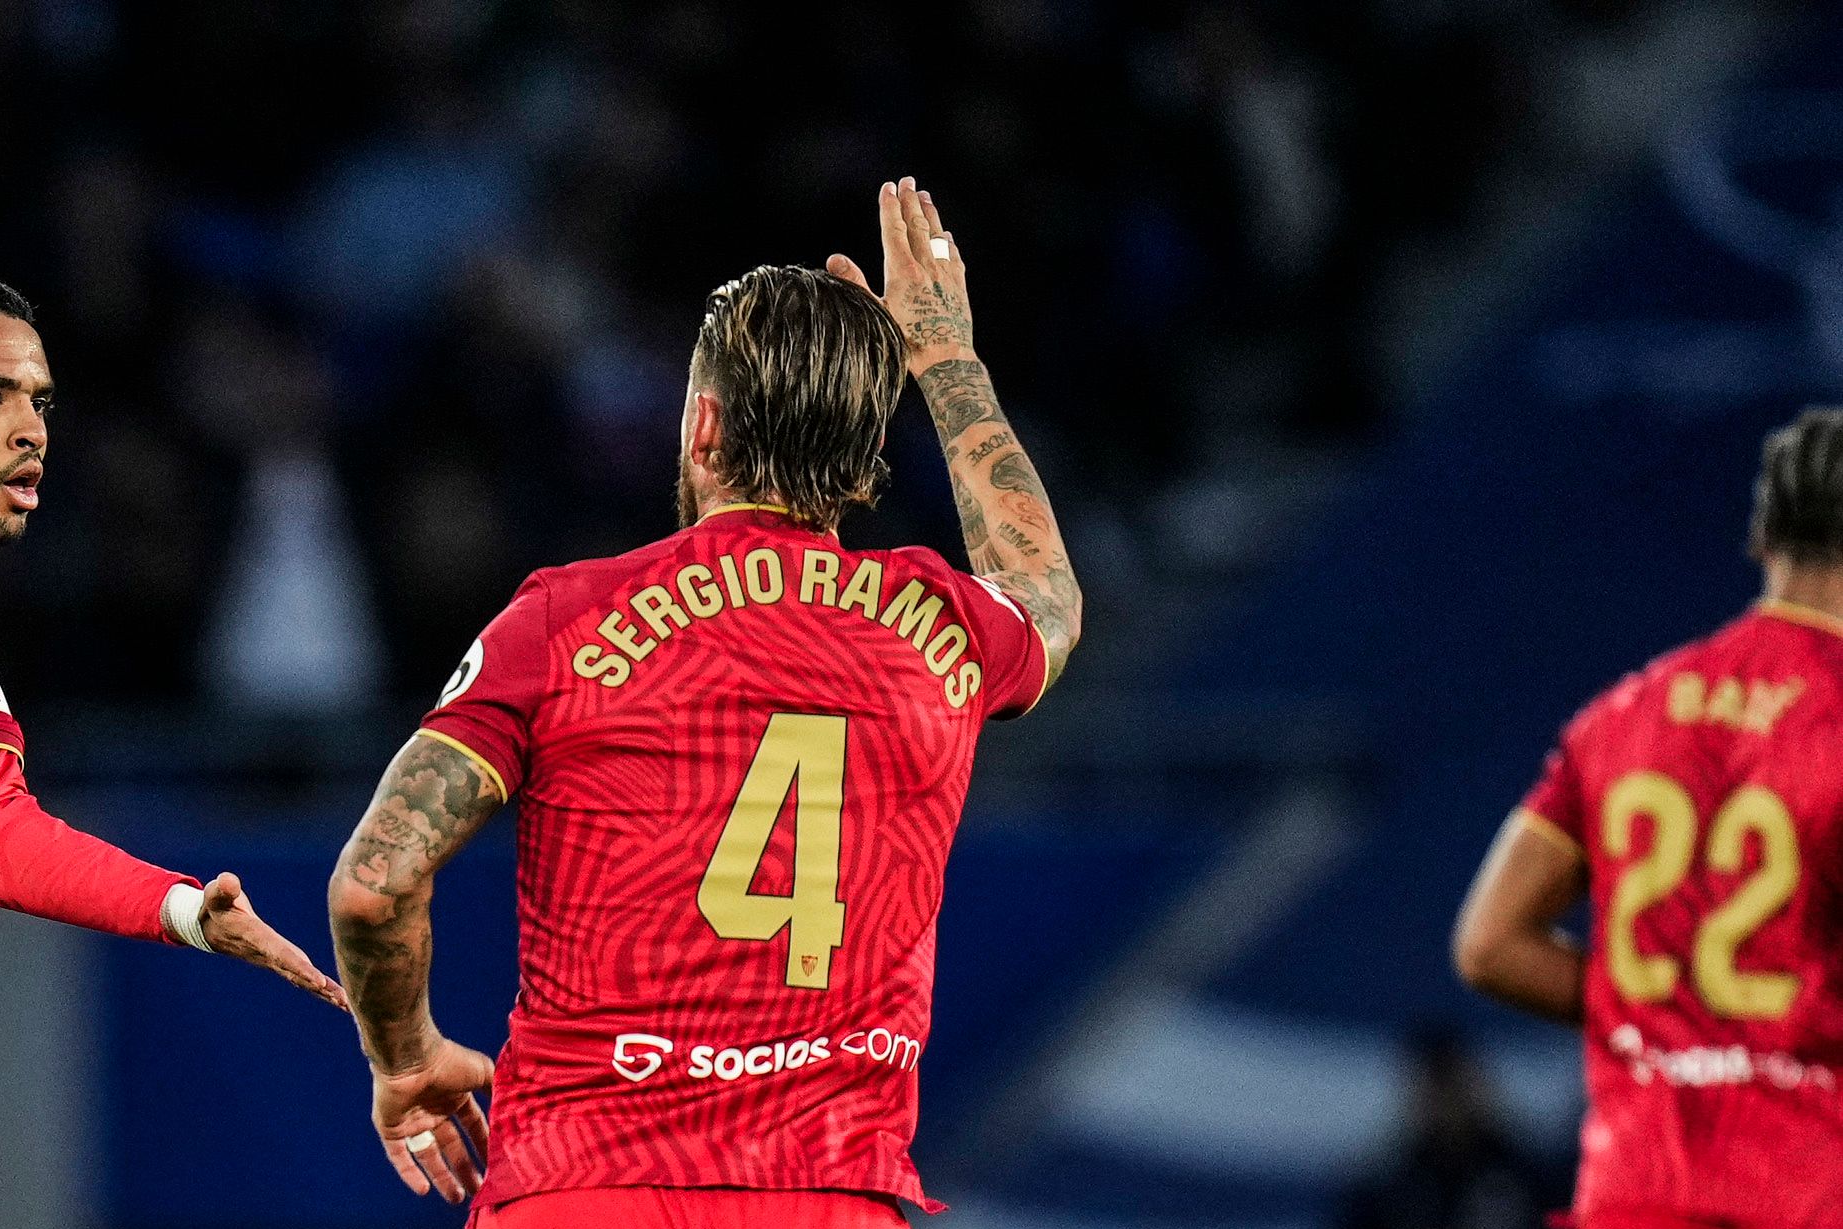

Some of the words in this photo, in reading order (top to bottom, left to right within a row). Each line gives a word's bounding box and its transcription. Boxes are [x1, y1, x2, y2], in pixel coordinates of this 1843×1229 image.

[572, 547, 785, 688] SERGIO
[799, 548, 982, 709] RAMOS
[697, 712, 847, 990] 4
[1603, 771, 1801, 1019] 22
